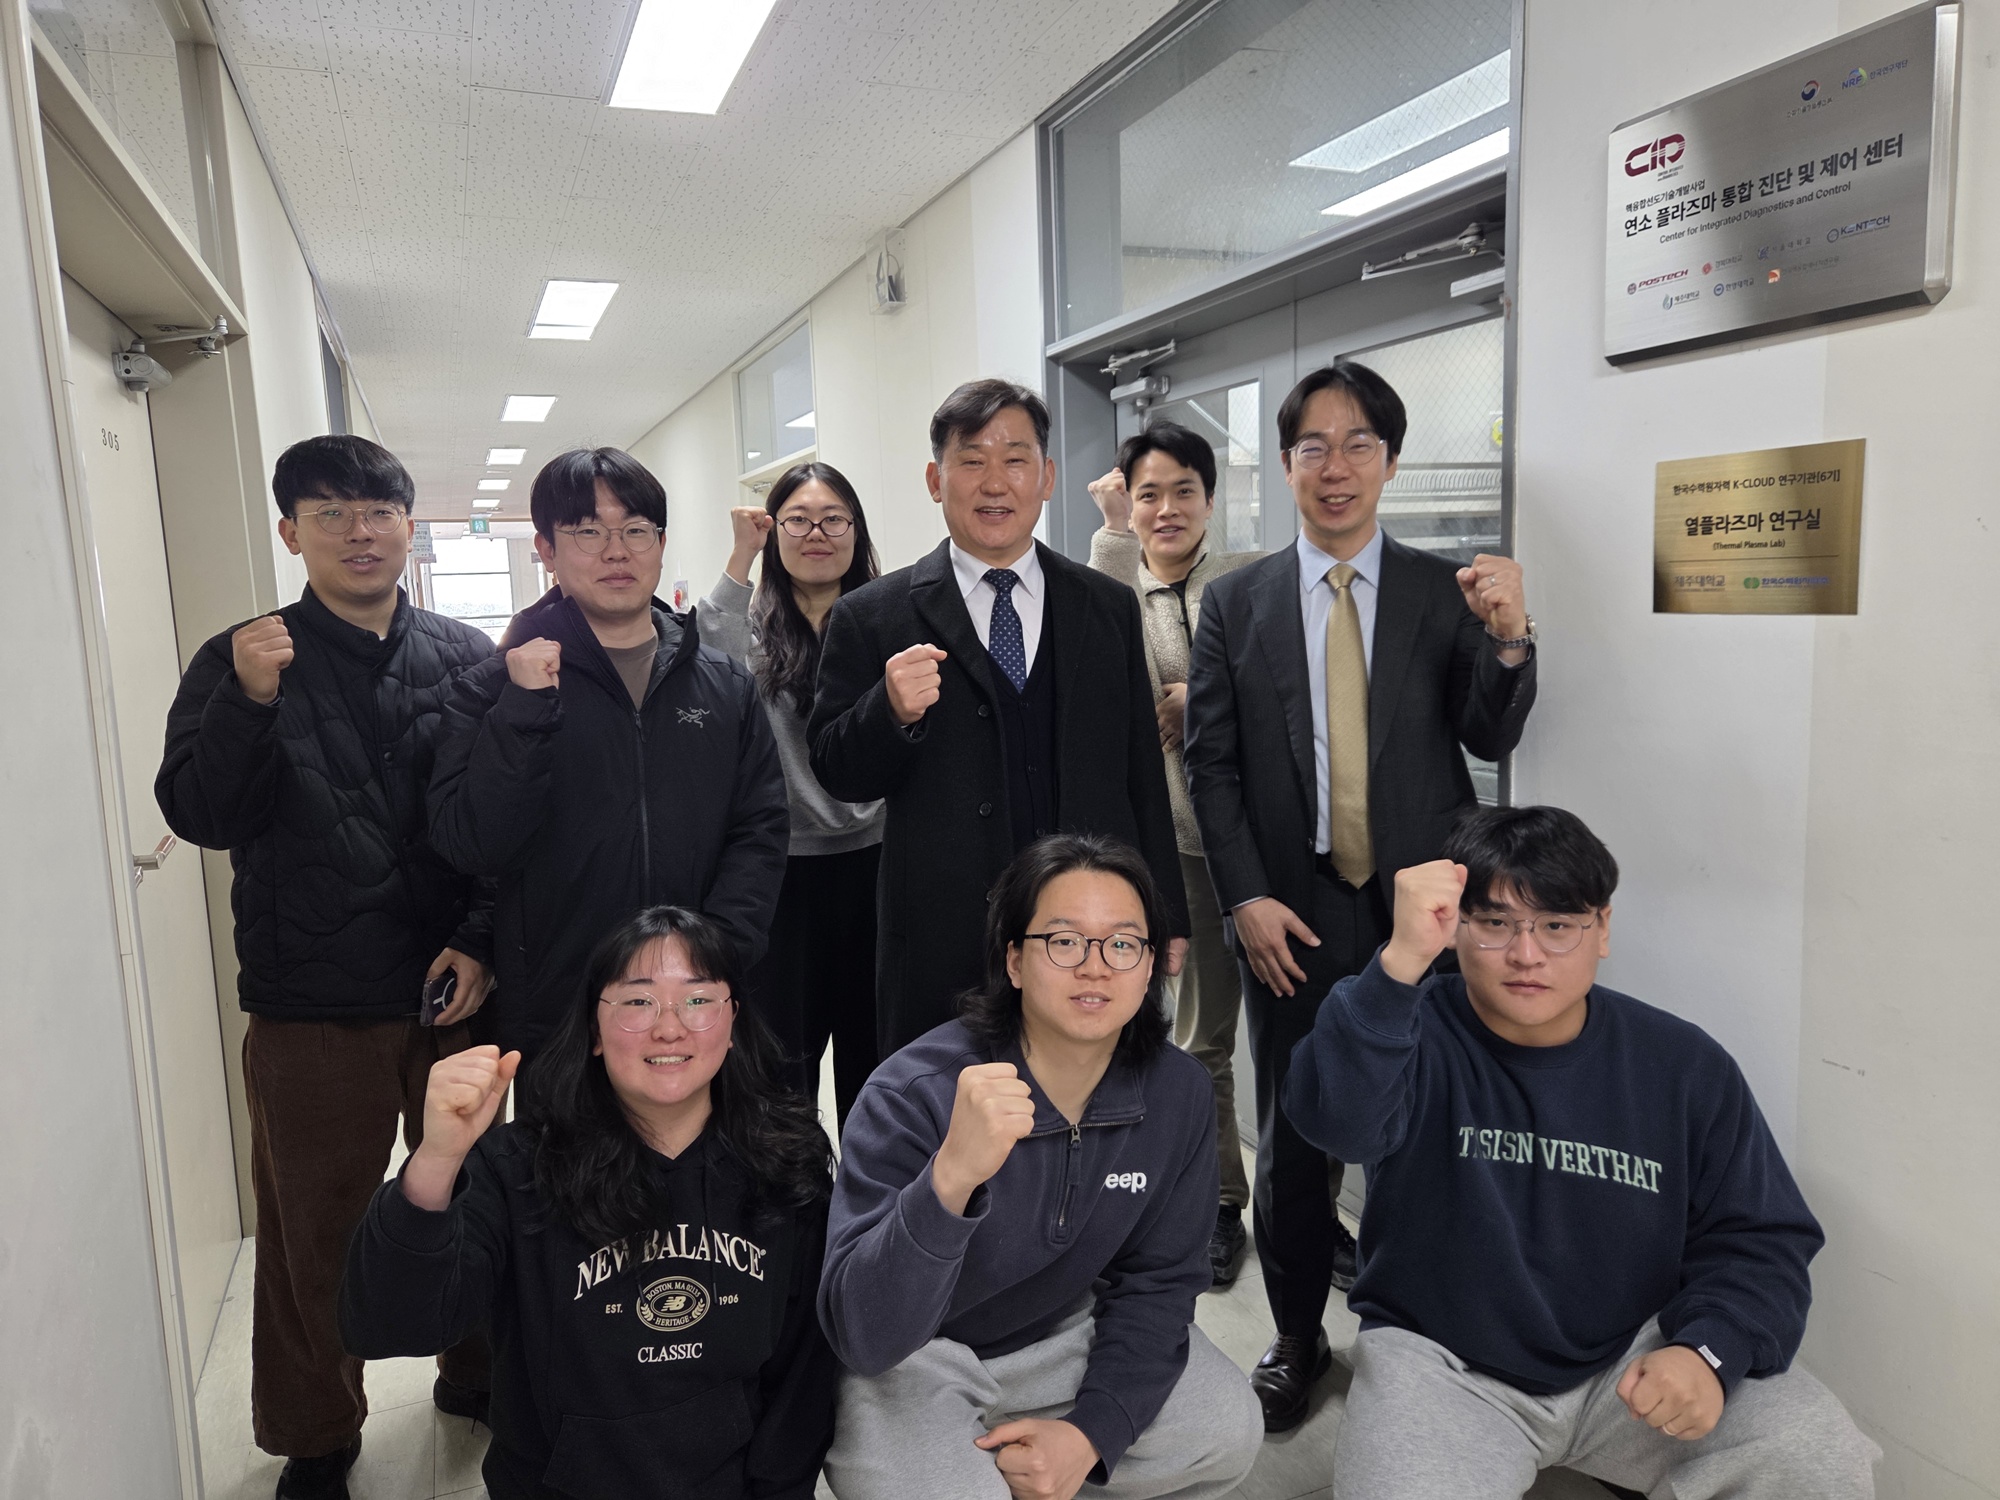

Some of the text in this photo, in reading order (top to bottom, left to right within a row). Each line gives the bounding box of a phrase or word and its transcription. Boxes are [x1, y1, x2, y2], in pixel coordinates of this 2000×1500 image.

[1841, 75, 1863, 90] NRF
[1624, 133, 1904, 238] 연소 플라즈마 통합 진단 및 제어 센터
[1659, 181, 1852, 244] Center for Integrated Diagnostics and Control
[1638, 268, 1689, 288] POSTECH
[101, 427, 120, 451] 305
[1673, 469, 1841, 496] 한국수력원자력 K-CLOUD 연구기관[6기]
[1685, 508, 1822, 537] 열플라즈마 연구실
[1713, 539, 1786, 551] (Thermal Plasma Lab)
[1674, 574, 1726, 588] 제주대학교
[1104, 1171, 1147, 1194] eep
[573, 1223, 766, 1301] NEW BALANCE
[674, 1281, 686, 1290] MA
[605, 1303, 623, 1314] EST.
[718, 1295, 739, 1306] 1906
[655, 1315, 690, 1326] HERITAGE
[637, 1342, 703, 1363] CLASSIC
